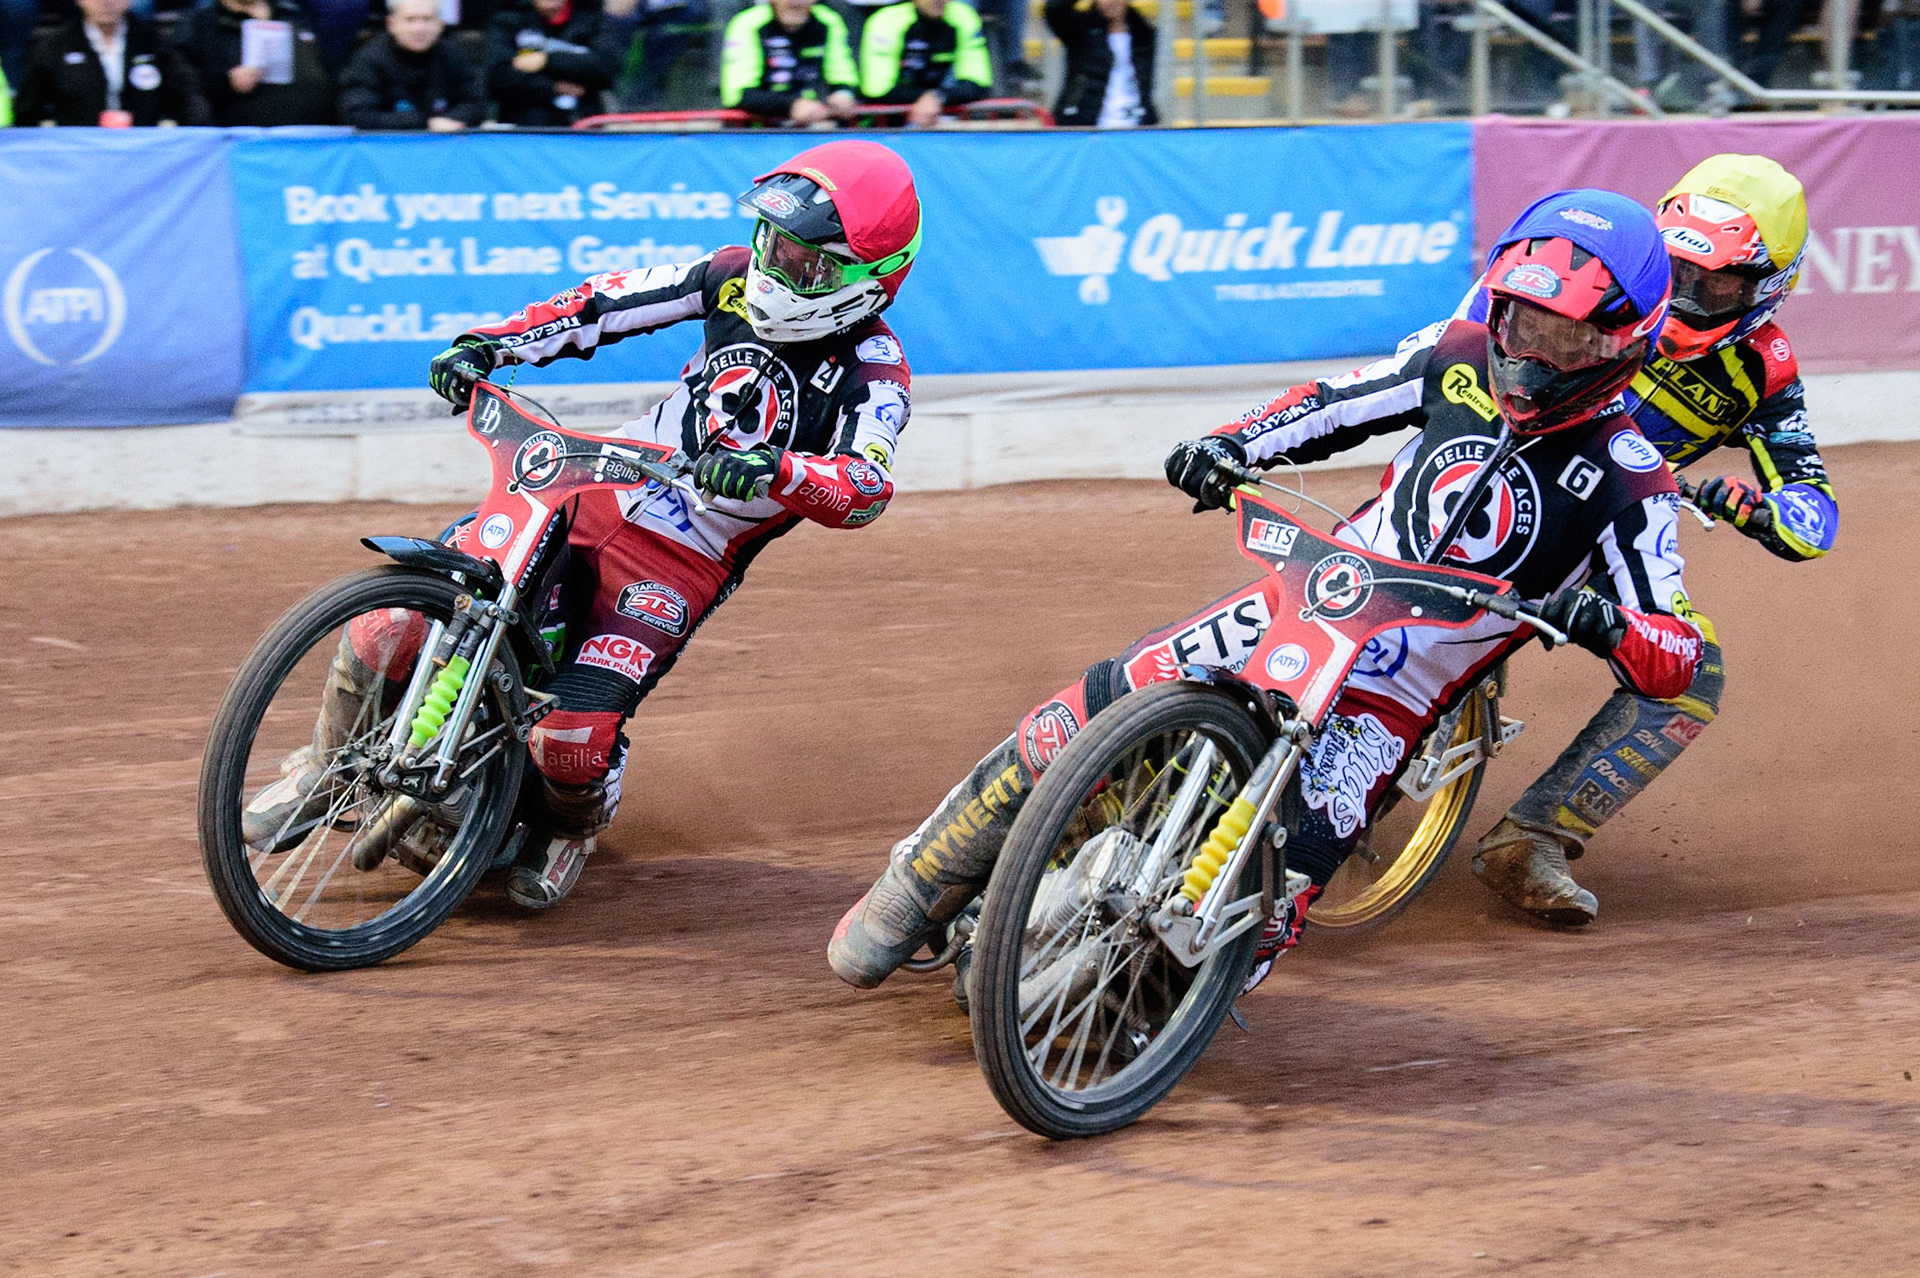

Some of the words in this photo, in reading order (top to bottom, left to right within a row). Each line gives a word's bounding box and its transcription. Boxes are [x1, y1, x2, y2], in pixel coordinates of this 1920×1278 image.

[284, 183, 391, 225] Book
[393, 193, 486, 230] your
[492, 185, 584, 221] next
[588, 182, 733, 220] Service
[293, 243, 328, 279] at
[335, 237, 454, 283] Quick
[461, 236, 562, 275] Lane
[1128, 212, 1305, 282] Quick
[1306, 210, 1459, 269] Lane
[1509, 270, 1551, 289] STS
[711, 351, 754, 374] BELLE
[777, 389, 792, 430] ACES
[817, 366, 834, 391] 4
[1447, 369, 1495, 416] Rentruck
[1651, 357, 1727, 416] PLAN
[1621, 437, 1652, 462] ATPI
[1434, 444, 1486, 471] BELLE
[1514, 487, 1534, 535] ACES
[1566, 459, 1597, 495] 6
[801, 482, 852, 512] agilia
[484, 521, 508, 539] ATPI
[1264, 523, 1296, 546] FTS
[1317, 555, 1342, 574] BELLE
[1345, 556, 1361, 568] VUE
[626, 582, 687, 607] STAKEFORD
[628, 593, 682, 620] STS
[621, 606, 642, 618] TIRE
[641, 614, 681, 634] SERVICES
[582, 635, 651, 672] NGK
[1172, 599, 1262, 678] FTS
[578, 655, 612, 669] SPARK
[1275, 654, 1300, 670] ATPI
[1056, 705, 1078, 738] STAKE
[547, 747, 603, 772] agilia
[1336, 716, 1402, 834] Buds
